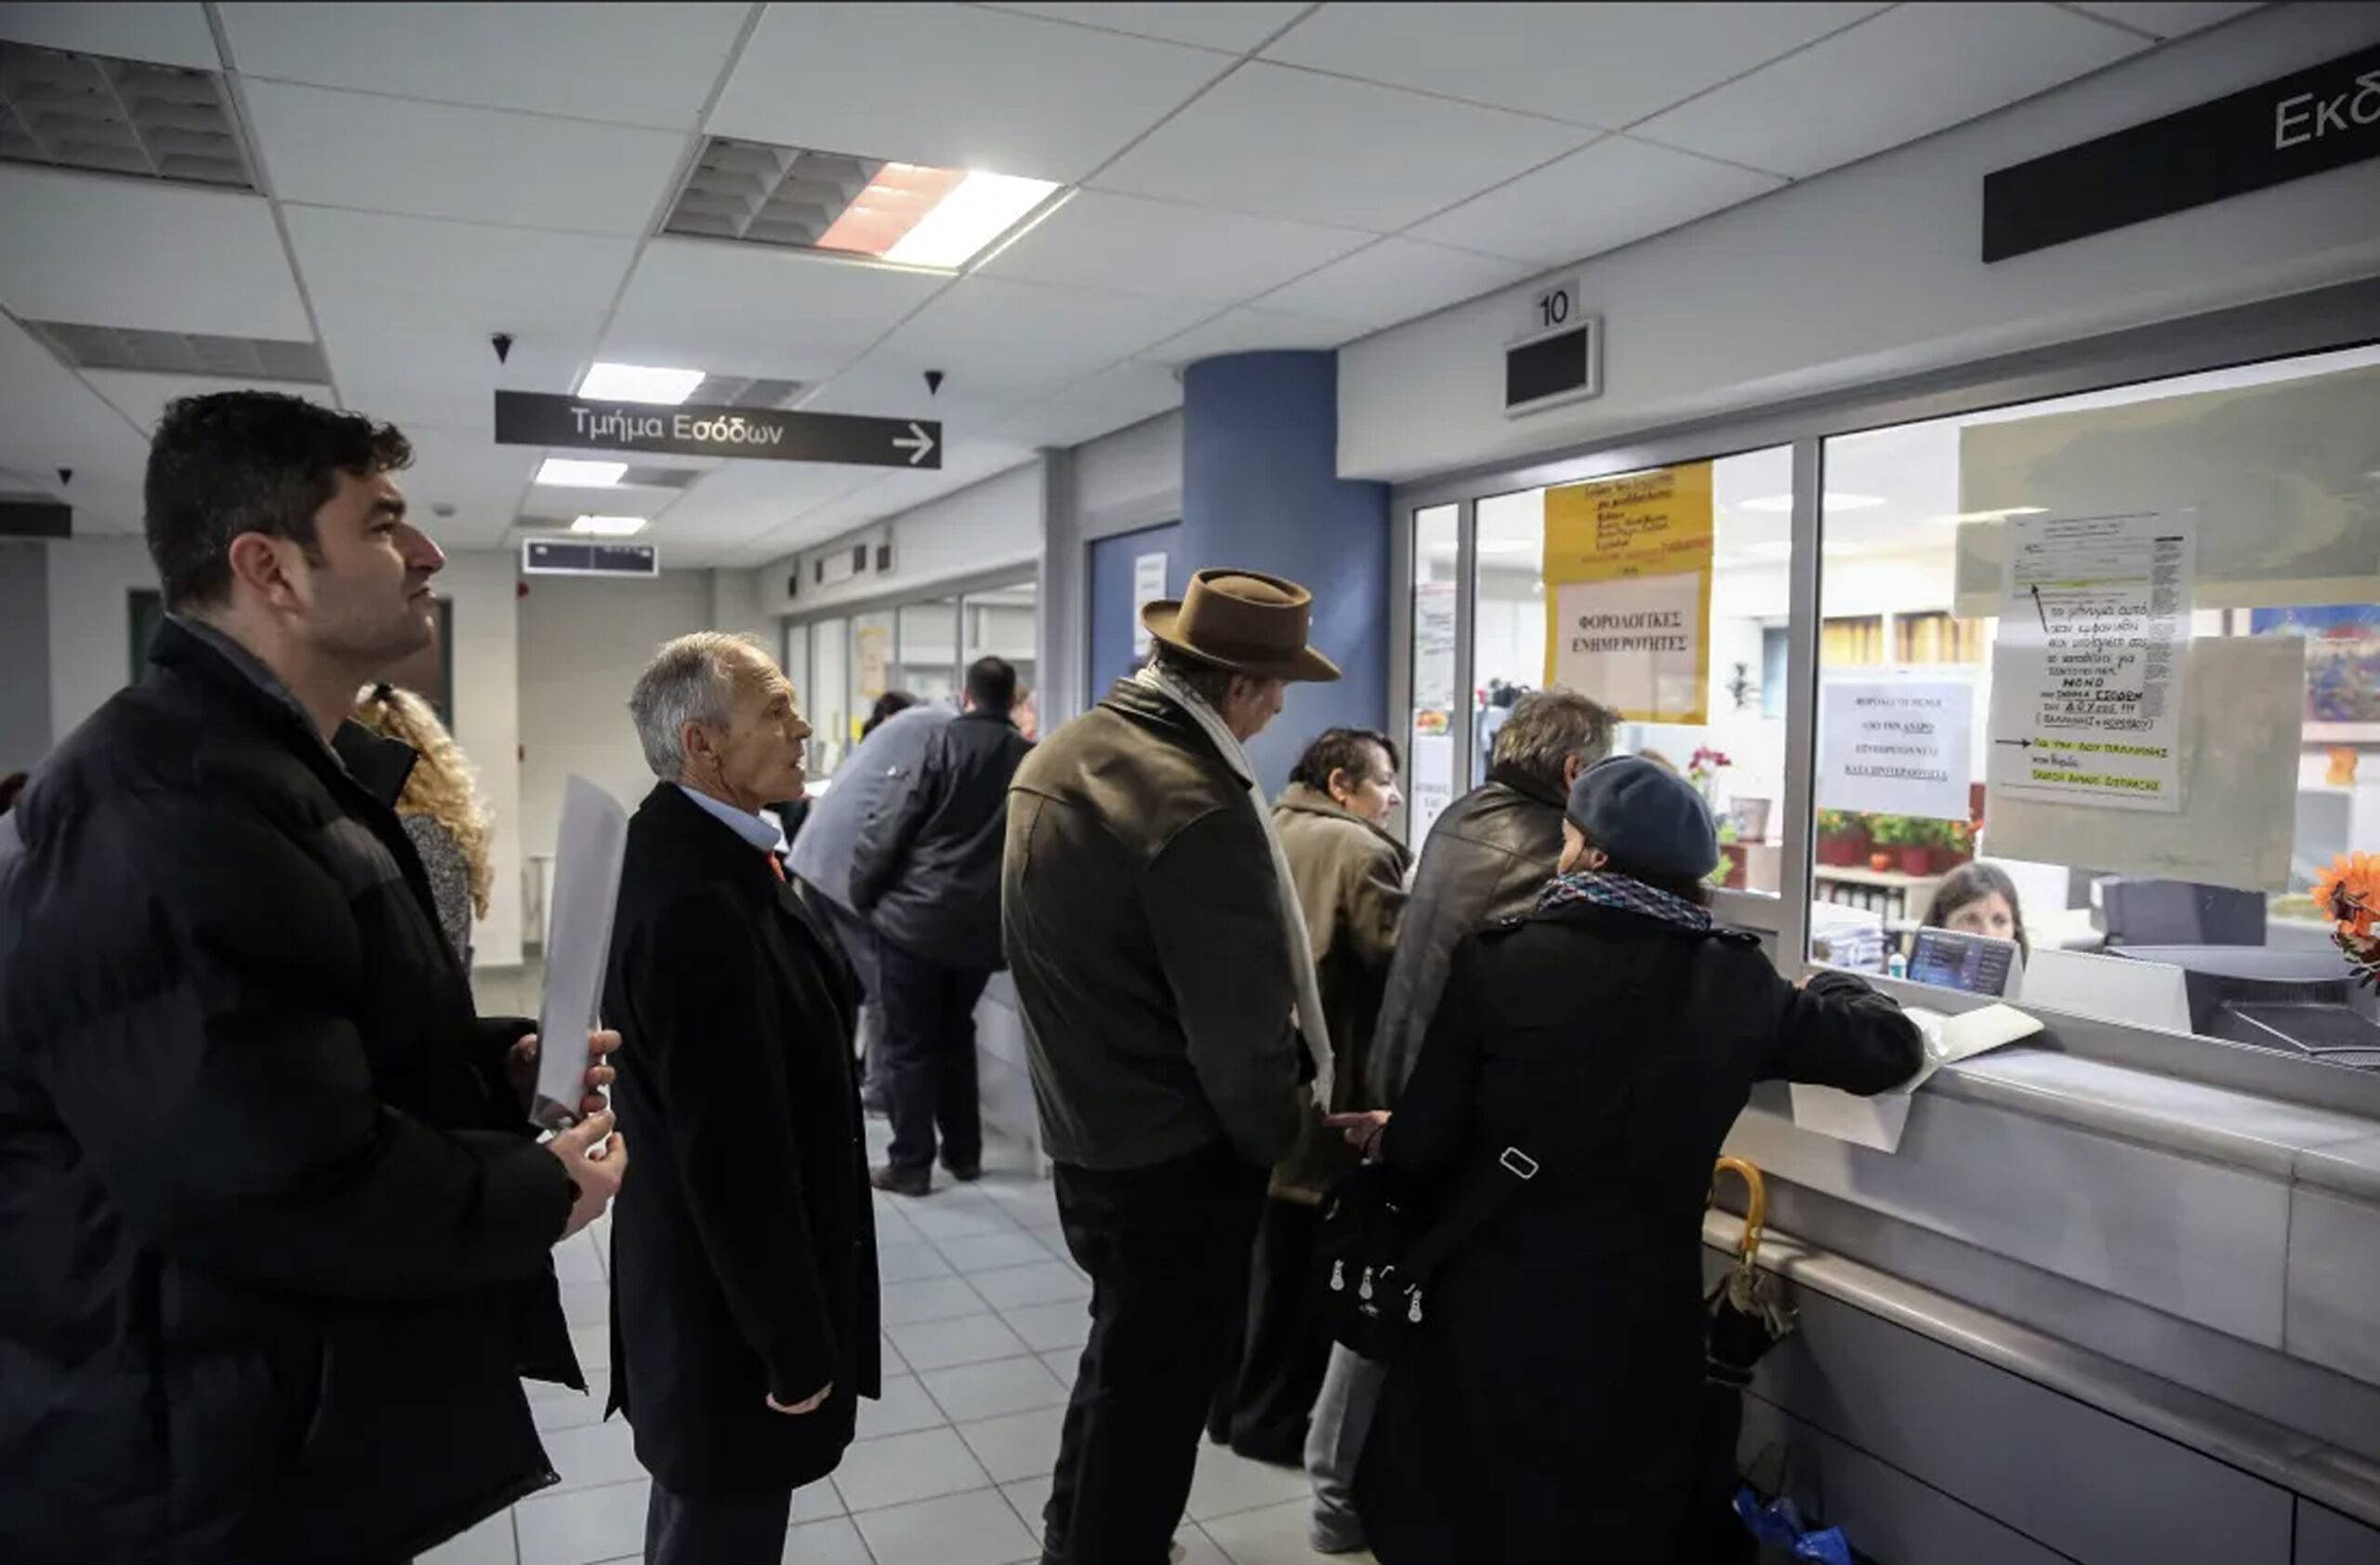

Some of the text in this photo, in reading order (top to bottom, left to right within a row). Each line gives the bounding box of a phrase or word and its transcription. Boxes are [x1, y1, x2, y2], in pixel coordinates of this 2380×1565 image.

[1540, 290, 1569, 326] 10
[570, 407, 784, 444] Τμήμα Εσόδων
[1579, 611, 1682, 630] ΦΟΡΟΛΟΓΙΚΕΣ
[1572, 636, 1687, 653] ΕΝΗΜΕΡΟΤΗΤΕΣ
